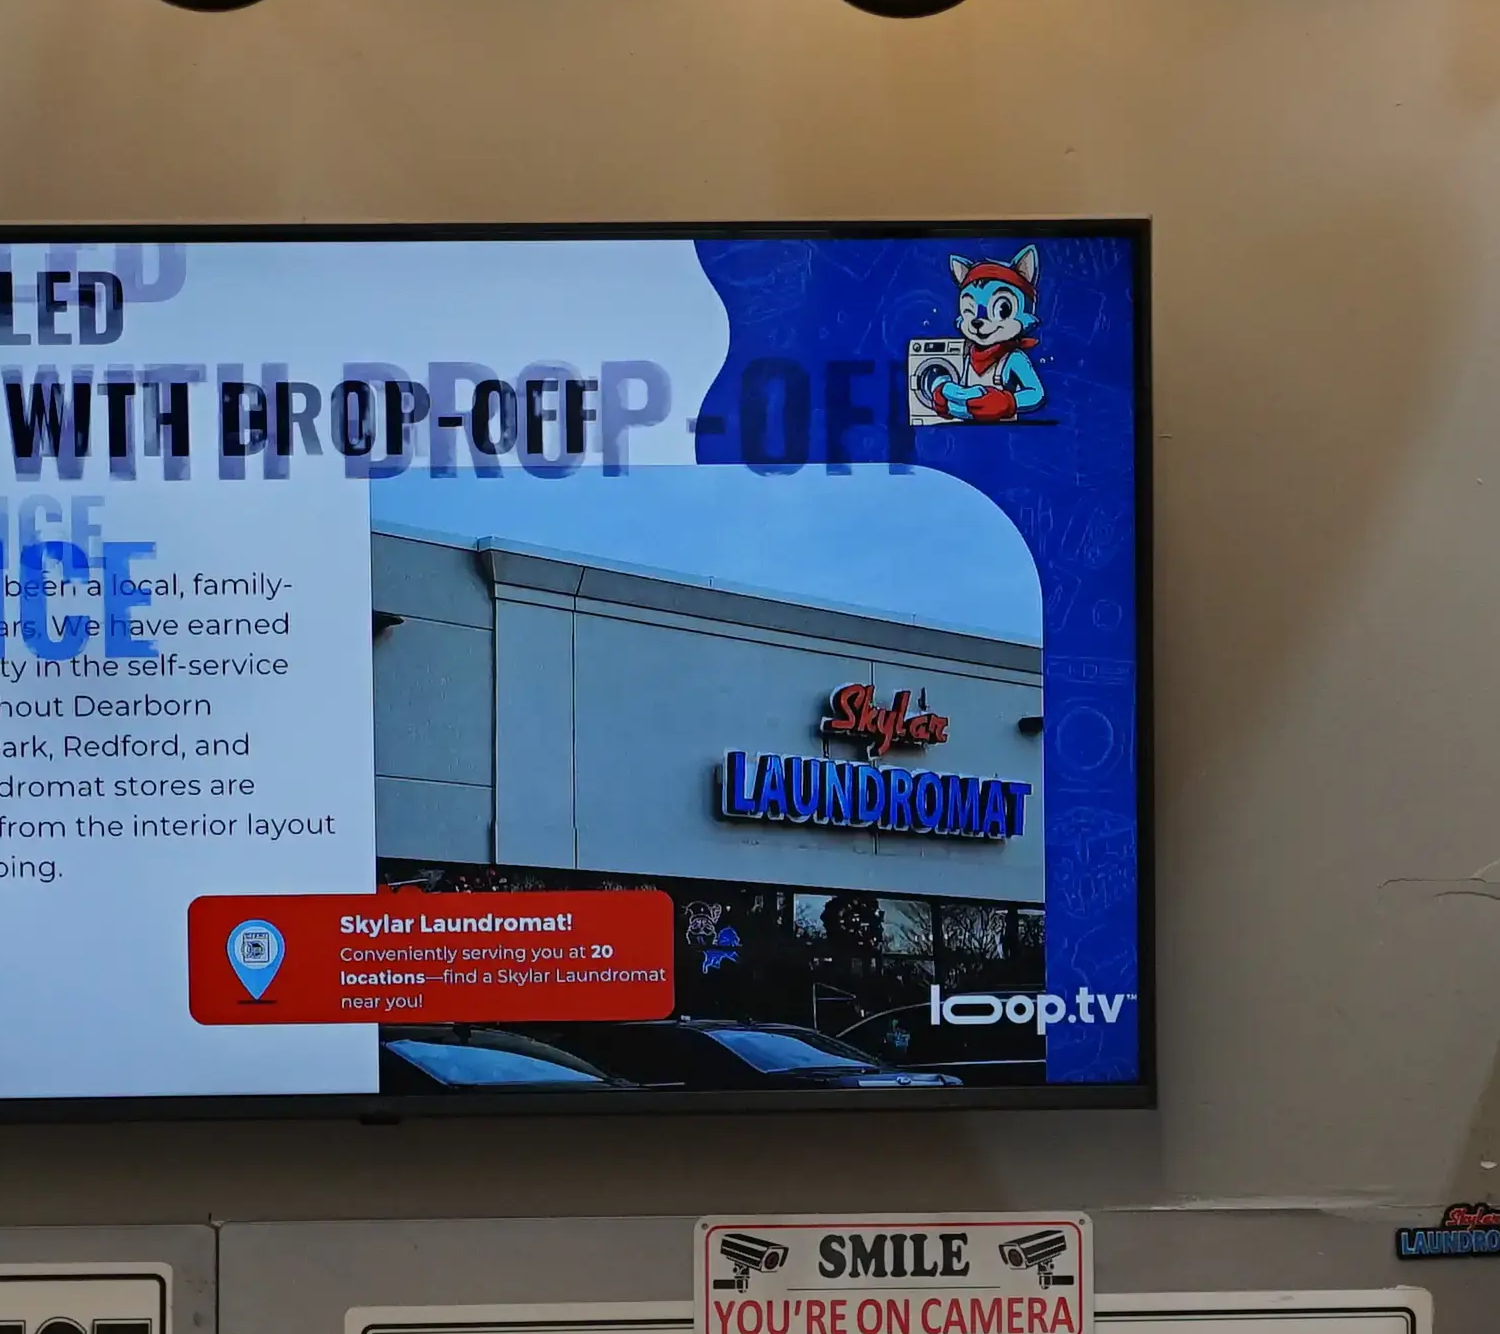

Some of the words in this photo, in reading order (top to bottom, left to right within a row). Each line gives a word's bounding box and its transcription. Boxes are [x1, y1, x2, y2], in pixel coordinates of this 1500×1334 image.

[5, 574, 76, 598] been
[87, 579, 101, 597] a
[112, 573, 185, 599] local,
[194, 572, 293, 600] family-
[51, 615, 100, 638] We
[111, 614, 179, 637] have
[188, 612, 290, 636] earned
[36, 655, 61, 677] in
[69, 655, 119, 677] the
[127, 653, 289, 677] self-service
[74, 694, 211, 717] Dearborn
[829, 684, 950, 755] Skylar
[64, 733, 186, 760] Redford,
[195, 733, 249, 756] and
[114, 777, 202, 797] stores
[211, 779, 255, 796] are
[722, 749, 1033, 840] LAUNDROMAT
[75, 814, 124, 837] the
[133, 813, 238, 836] interior
[248, 812, 336, 841] layout
[339, 914, 414, 938] Skylar
[420, 913, 573, 934] Laundromat!
[340, 945, 457, 964] Conveniently
[462, 945, 526, 962] serving
[531, 946, 563, 961] you
[568, 946, 586, 959] at
[591, 945, 614, 959] 20
[341, 968, 477, 986] locations—find
[483, 971, 493, 983] a
[497, 968, 551, 987] Skylar
[555, 967, 667, 983] Laundromat
[341, 995, 381, 1009] near
[384, 994, 424, 1011] you!
[929, 985, 1127, 1036] loop.tv
[818, 1230, 971, 1279] SMILE
[921, 1296, 1075, 1334] CAMERA
